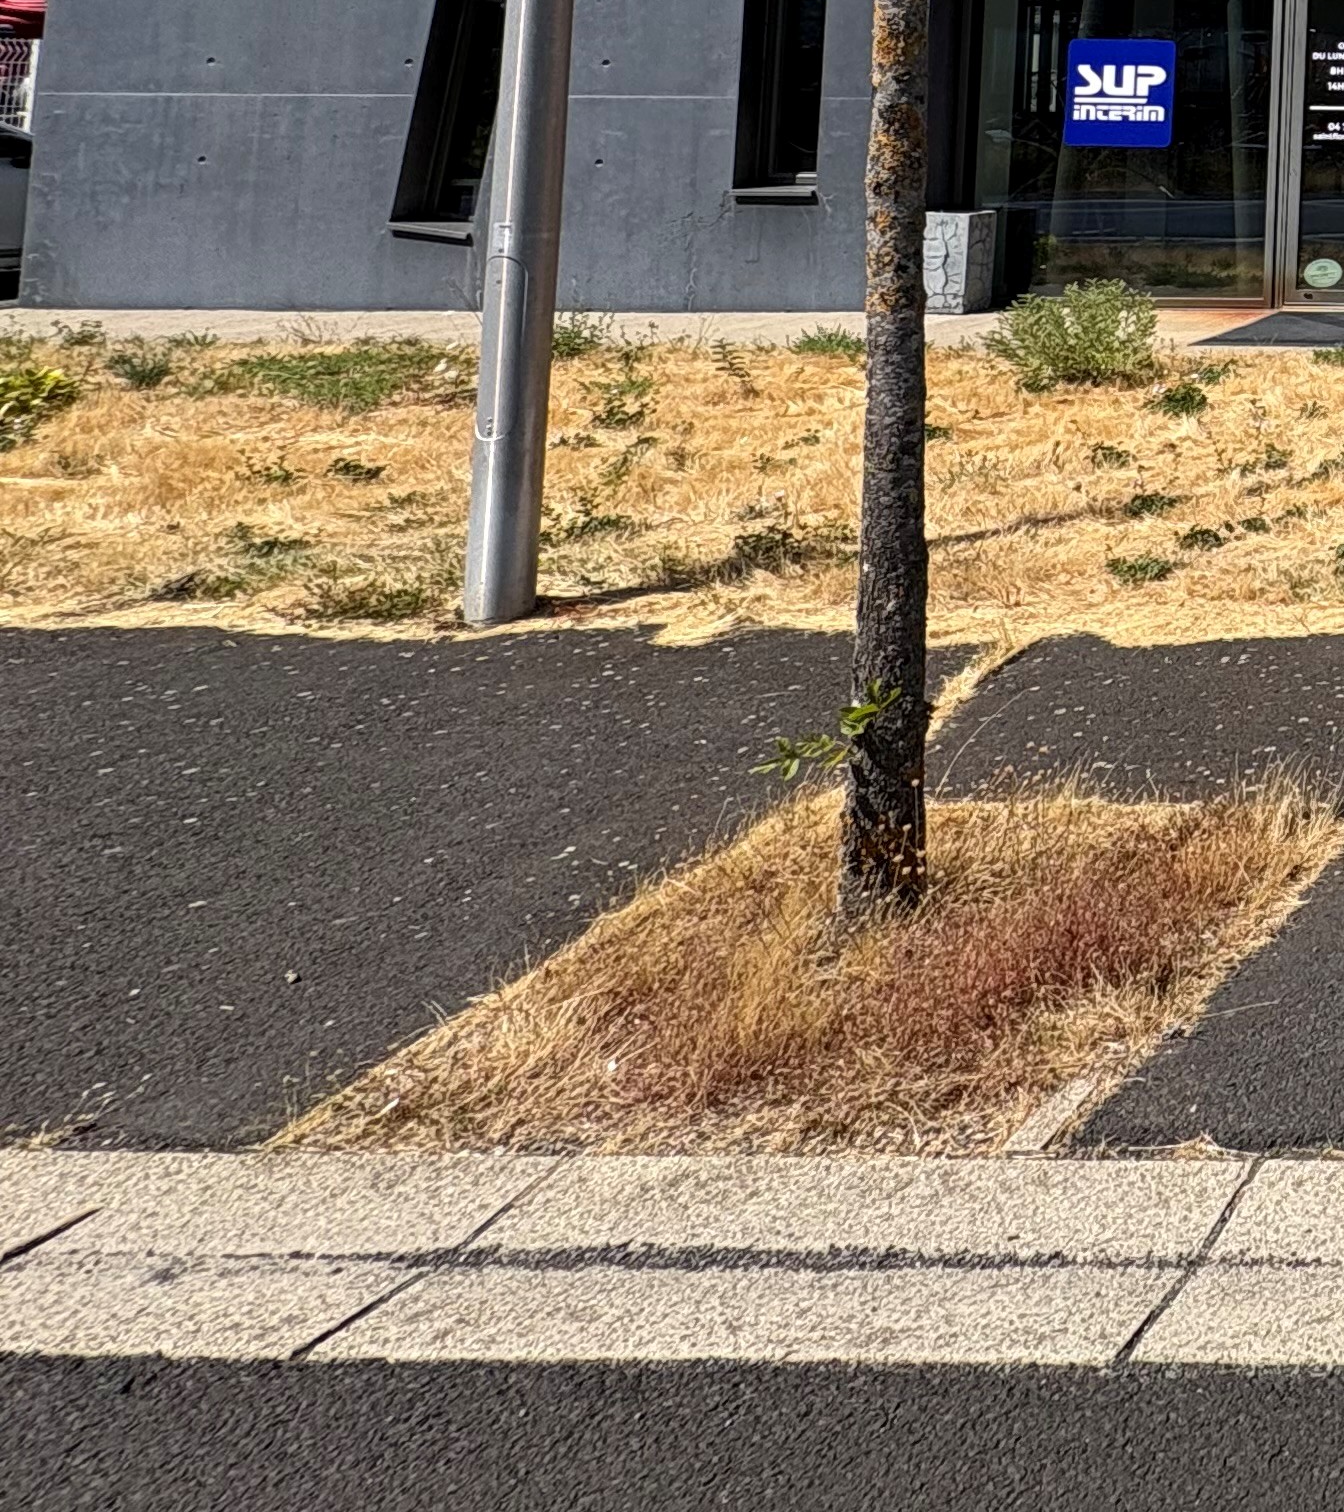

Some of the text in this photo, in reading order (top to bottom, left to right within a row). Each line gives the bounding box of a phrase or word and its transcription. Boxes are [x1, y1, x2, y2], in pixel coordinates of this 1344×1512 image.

[1312, 52, 1326, 60] DU
[1074, 64, 1167, 96] SUP
[1328, 123, 1341, 131] 04
